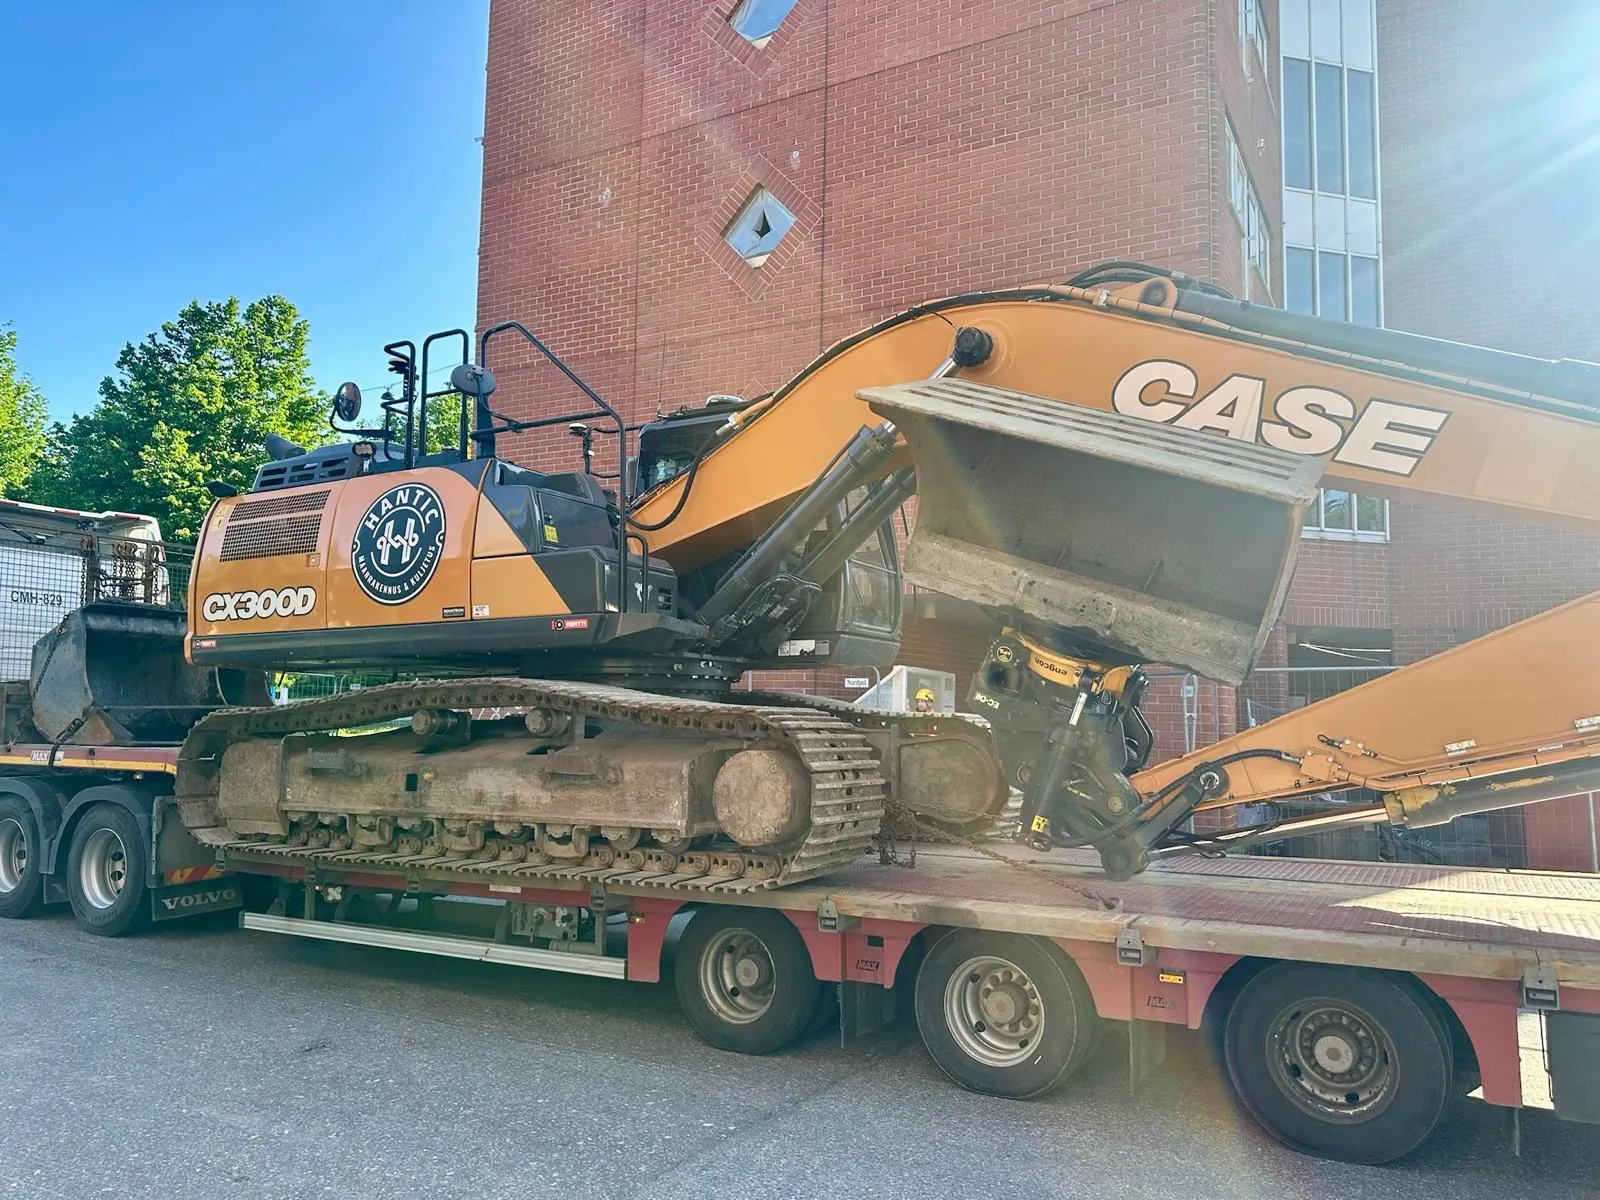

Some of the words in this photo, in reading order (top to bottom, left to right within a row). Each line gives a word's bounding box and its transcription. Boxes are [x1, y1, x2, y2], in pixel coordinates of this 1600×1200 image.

[1111, 358, 1453, 477] CASE
[364, 488, 439, 531] HANTIC
[358, 555, 401, 595] MAANRAKENNUS
[403, 582, 409, 591] &
[410, 545, 436, 586] KULJETUS
[11, 590, 62, 606] CMH-829
[202, 586, 317, 622] CX300D
[1034, 656, 1068, 676] engcon
[161, 889, 236, 910] VOLVO
